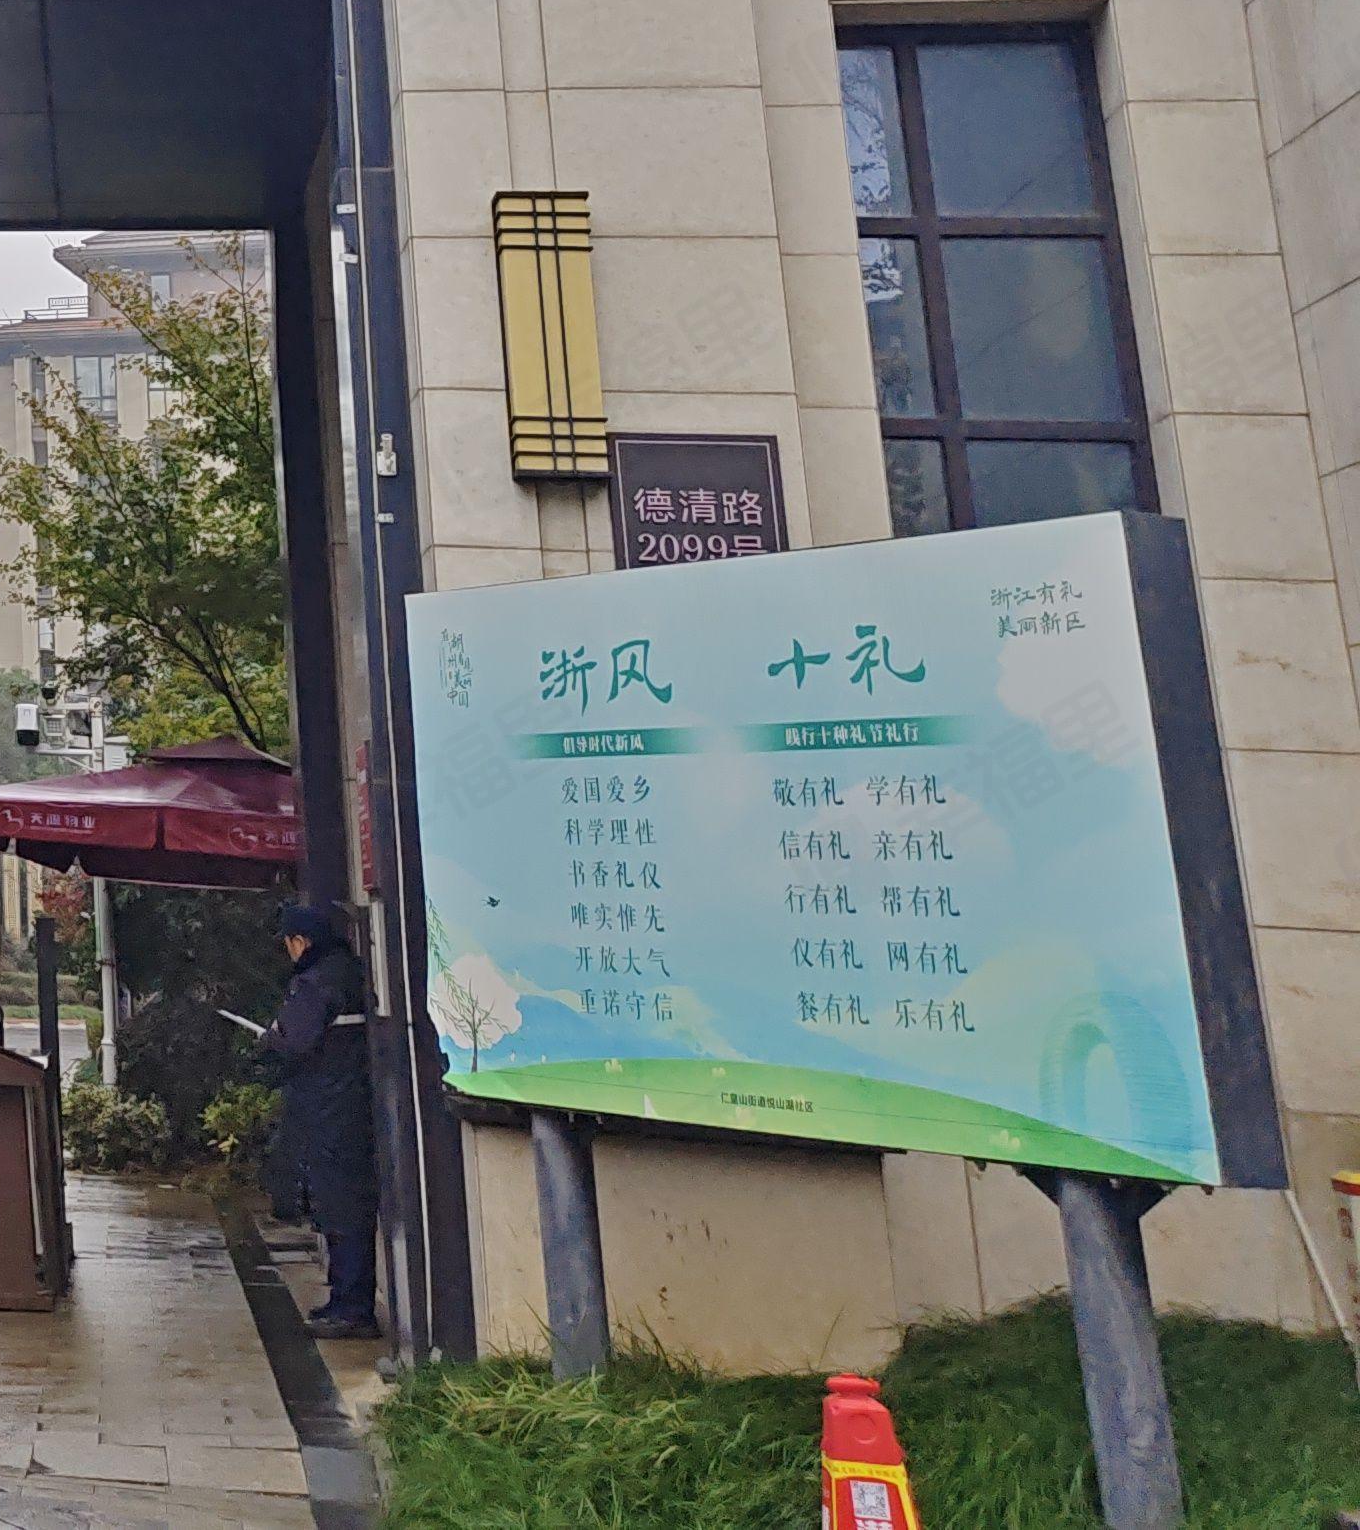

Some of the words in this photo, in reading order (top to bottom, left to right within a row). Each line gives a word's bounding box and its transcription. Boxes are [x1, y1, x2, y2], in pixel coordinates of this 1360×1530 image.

[633, 487, 763, 525] 德清路
[637, 533, 768, 562] 2099号
[991, 580, 1083, 610] 浙江有礼
[999, 611, 1086, 638] 美丽新区
[540, 639, 673, 717] 浙风
[767, 625, 926, 696] 十礼
[563, 733, 645, 754] 倡导时代新风
[561, 776, 651, 804] 爱国爱乡
[772, 778, 844, 807] 敬有礼
[866, 774, 946, 805] 学有礼
[564, 818, 656, 846] 科学理性
[780, 830, 850, 860] 信有礼
[874, 830, 954, 861] 亲有礼
[569, 861, 661, 890] 书香礼仪
[785, 884, 857, 915] 行有礼
[881, 885, 960, 917] 帮有礼
[576, 946, 671, 977] 开放大气
[791, 937, 863, 970] 仪有礼
[887, 940, 968, 974] 网有礼
[579, 990, 673, 1022] 重诺守信
[797, 991, 870, 1025] 餐有礼
[895, 998, 975, 1033] 乐有礼
